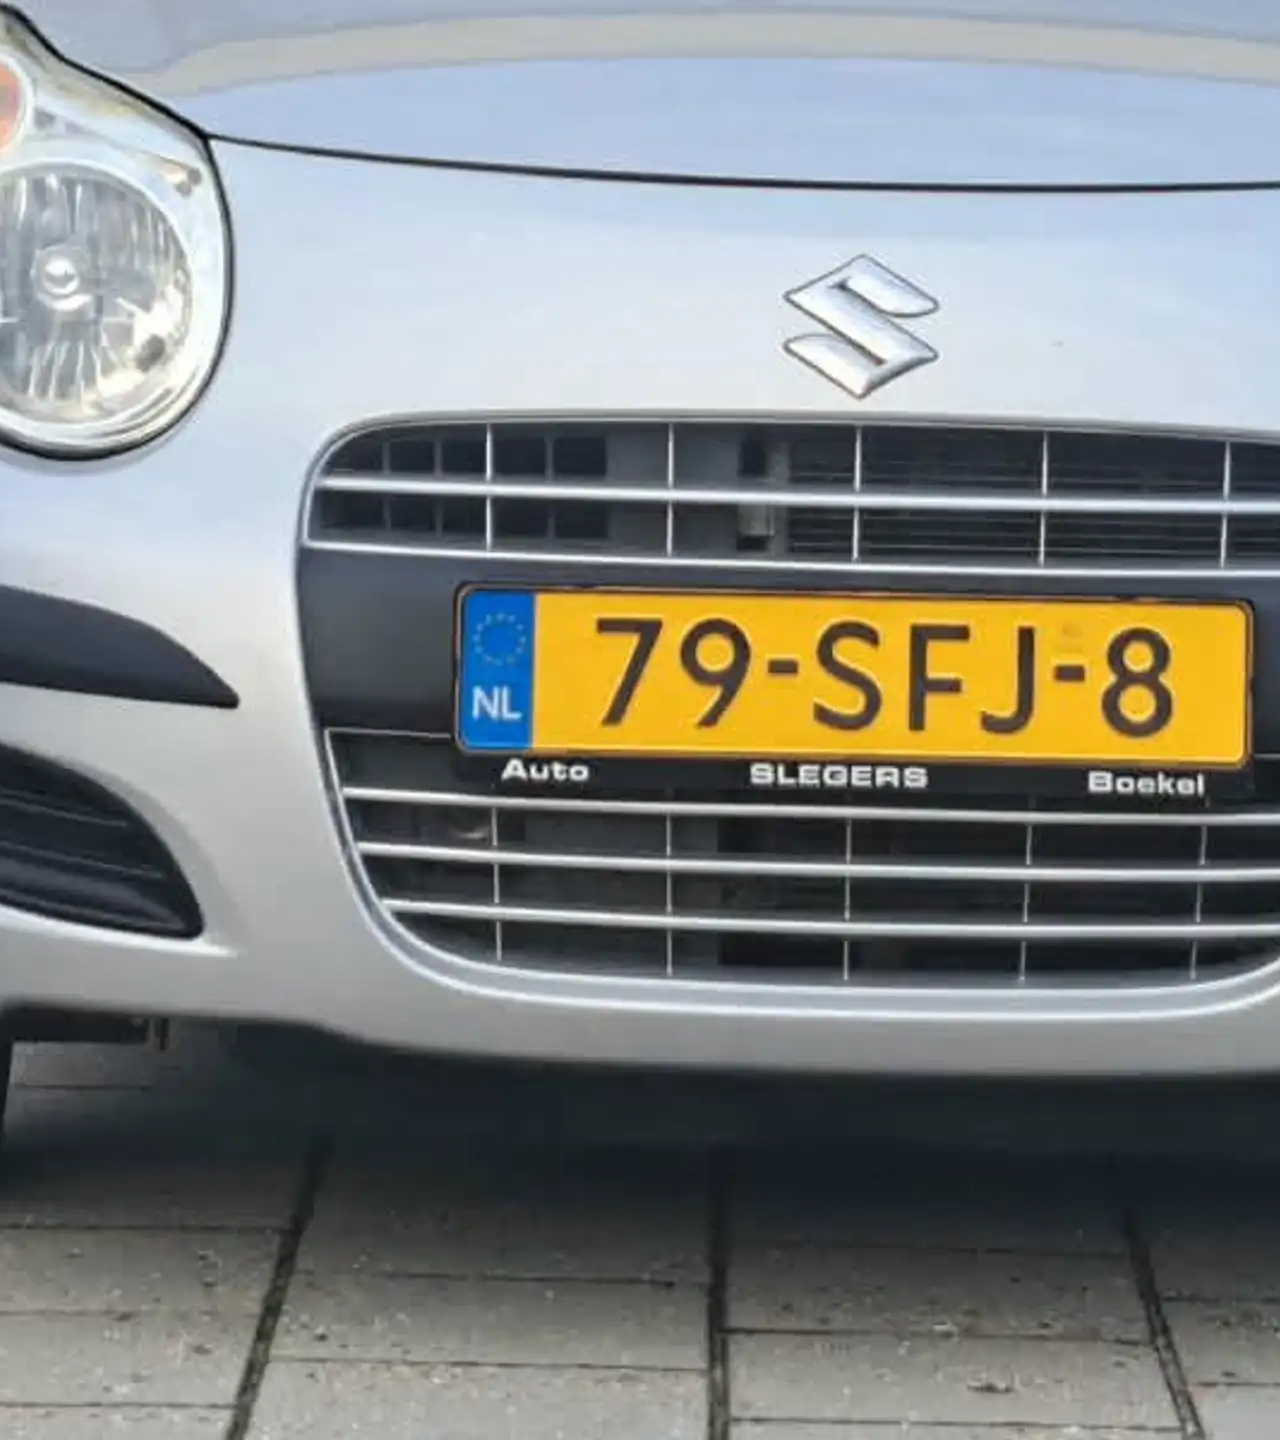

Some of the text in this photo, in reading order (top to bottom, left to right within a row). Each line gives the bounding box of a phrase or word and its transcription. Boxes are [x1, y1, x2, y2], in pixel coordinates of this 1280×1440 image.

[596, 617, 1174, 739] 79-SFJ-8
[471, 685, 522, 721] NL
[500, 758, 1206, 797] Auto SLEGERS Boekel
